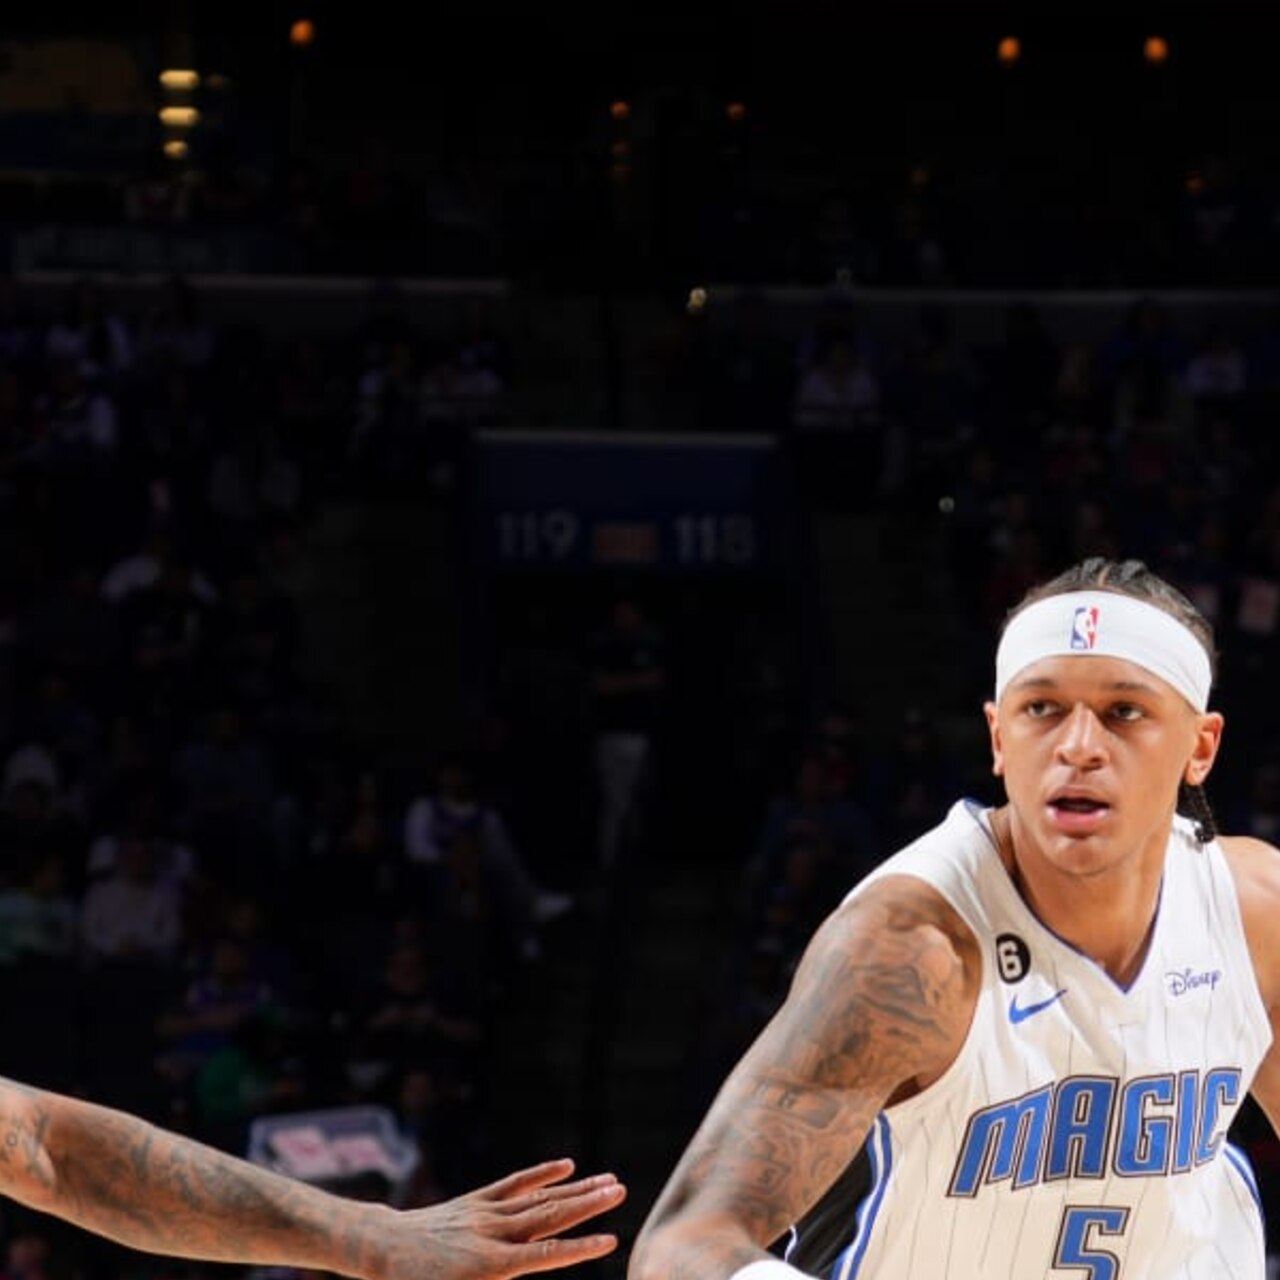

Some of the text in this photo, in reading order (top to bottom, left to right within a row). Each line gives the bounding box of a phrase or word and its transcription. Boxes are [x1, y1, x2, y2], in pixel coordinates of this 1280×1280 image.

[998, 939, 1022, 979] 6
[1166, 969, 1223, 996] Disney
[946, 1068, 1242, 1198] MAGIC
